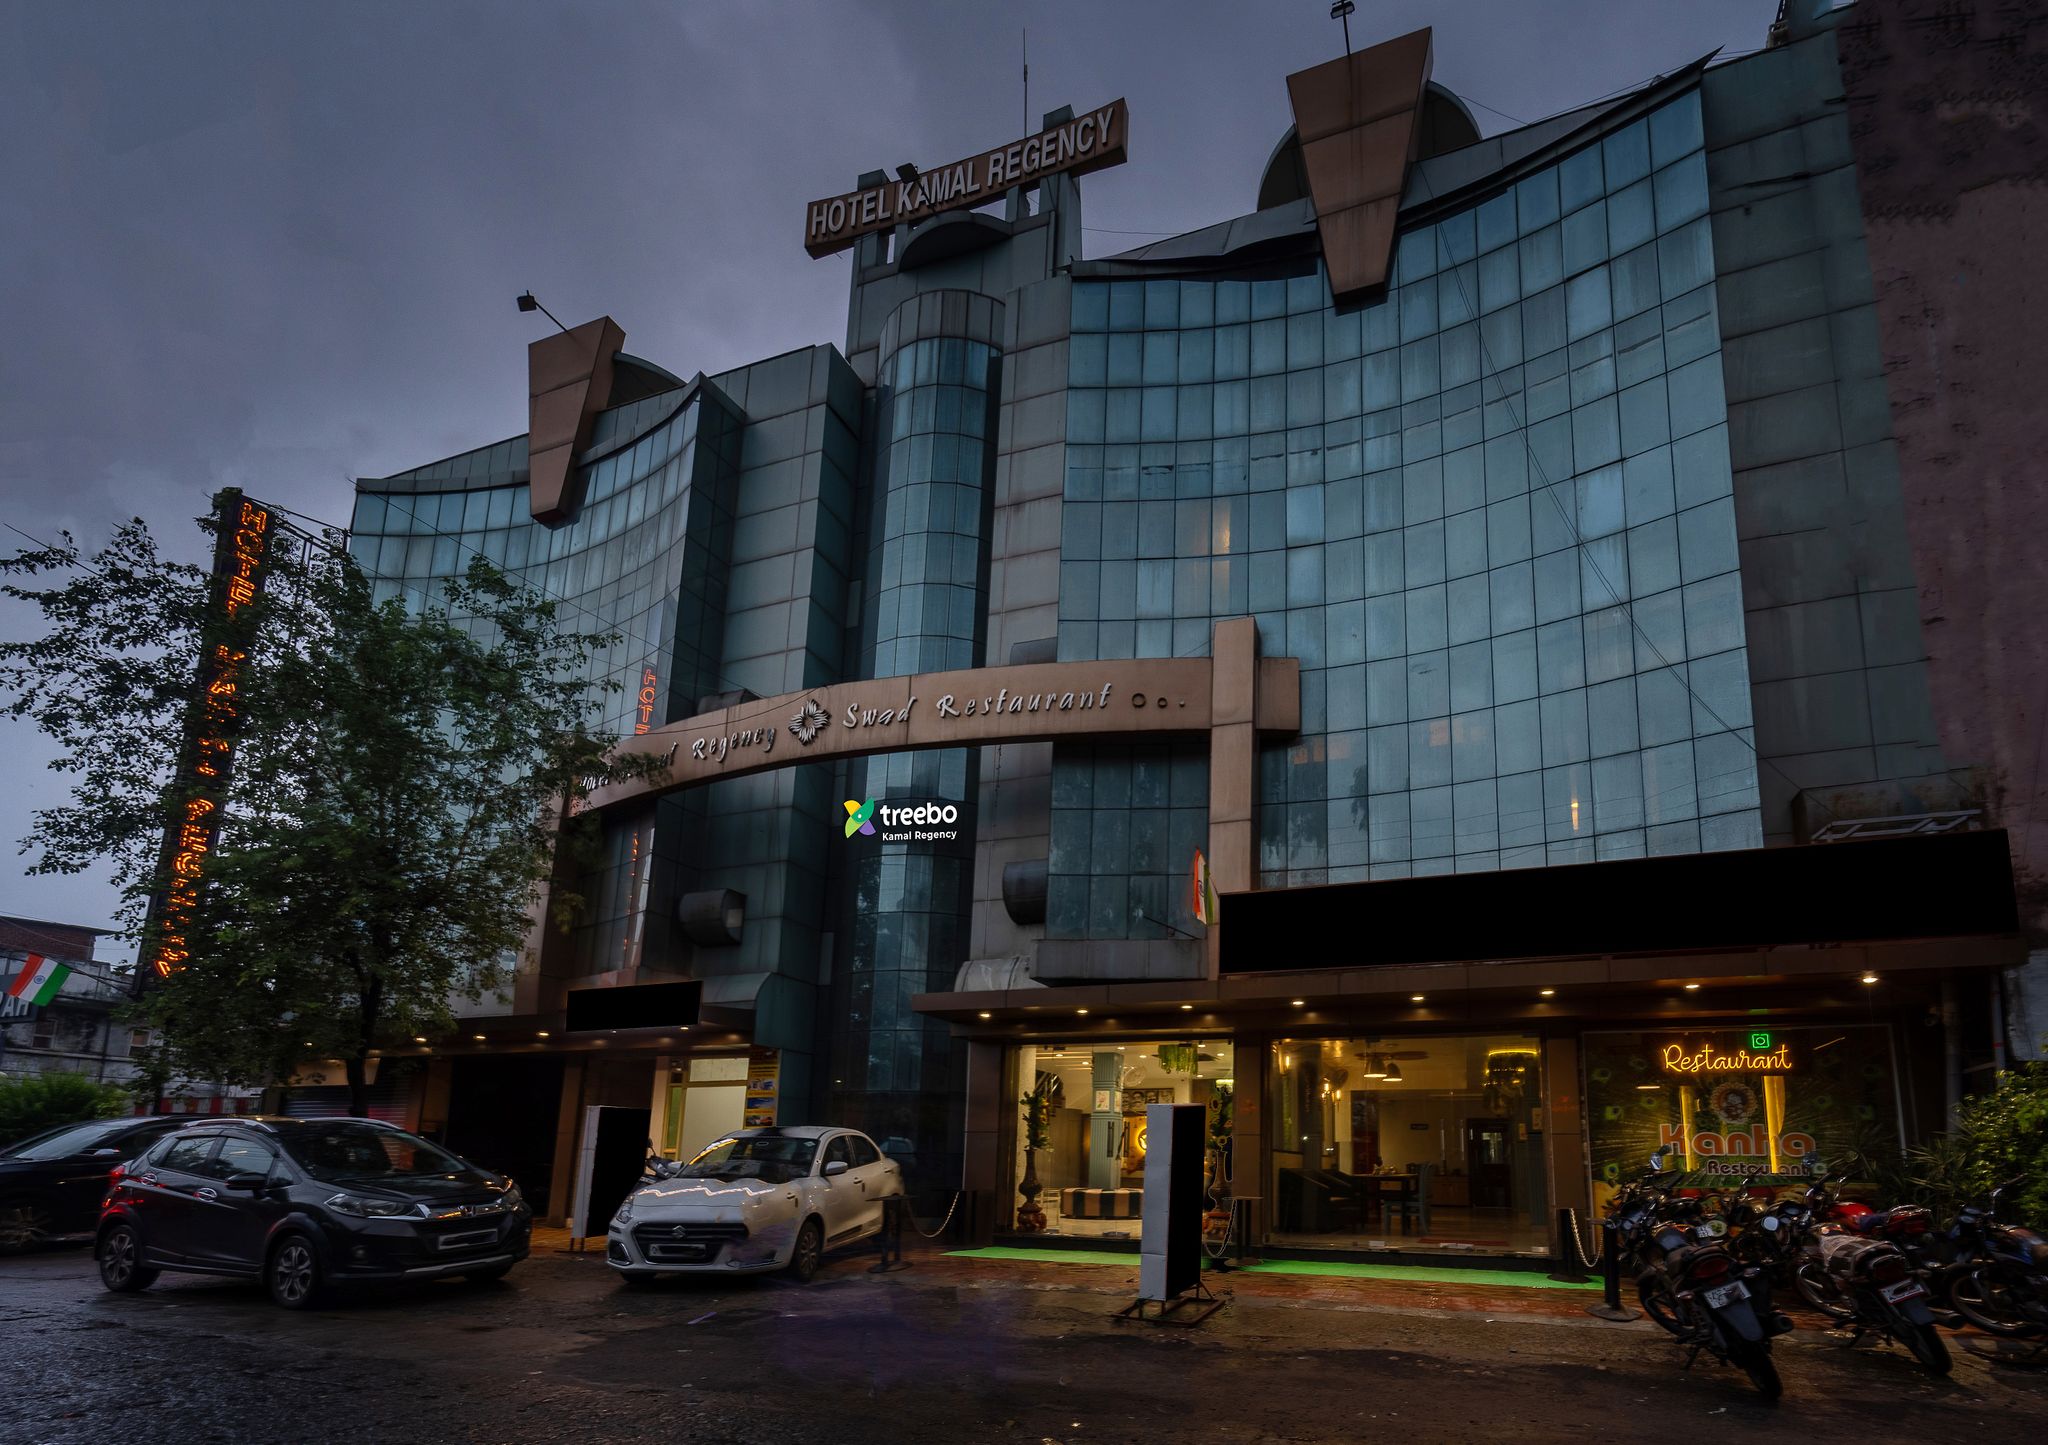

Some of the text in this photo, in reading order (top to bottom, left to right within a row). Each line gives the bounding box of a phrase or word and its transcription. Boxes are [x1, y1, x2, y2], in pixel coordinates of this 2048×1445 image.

[811, 107, 1117, 237] HOTEL KAMAL REGENCY
[842, 695, 917, 728] Swad
[936, 683, 1112, 719] Restaurant
[879, 802, 958, 826] treebo
[882, 830, 957, 841] Kamal Regency
[1663, 1044, 1792, 1072] Restaurant
[1660, 1123, 1816, 1157] Kanha
[1707, 1159, 1810, 1177] Restauant
